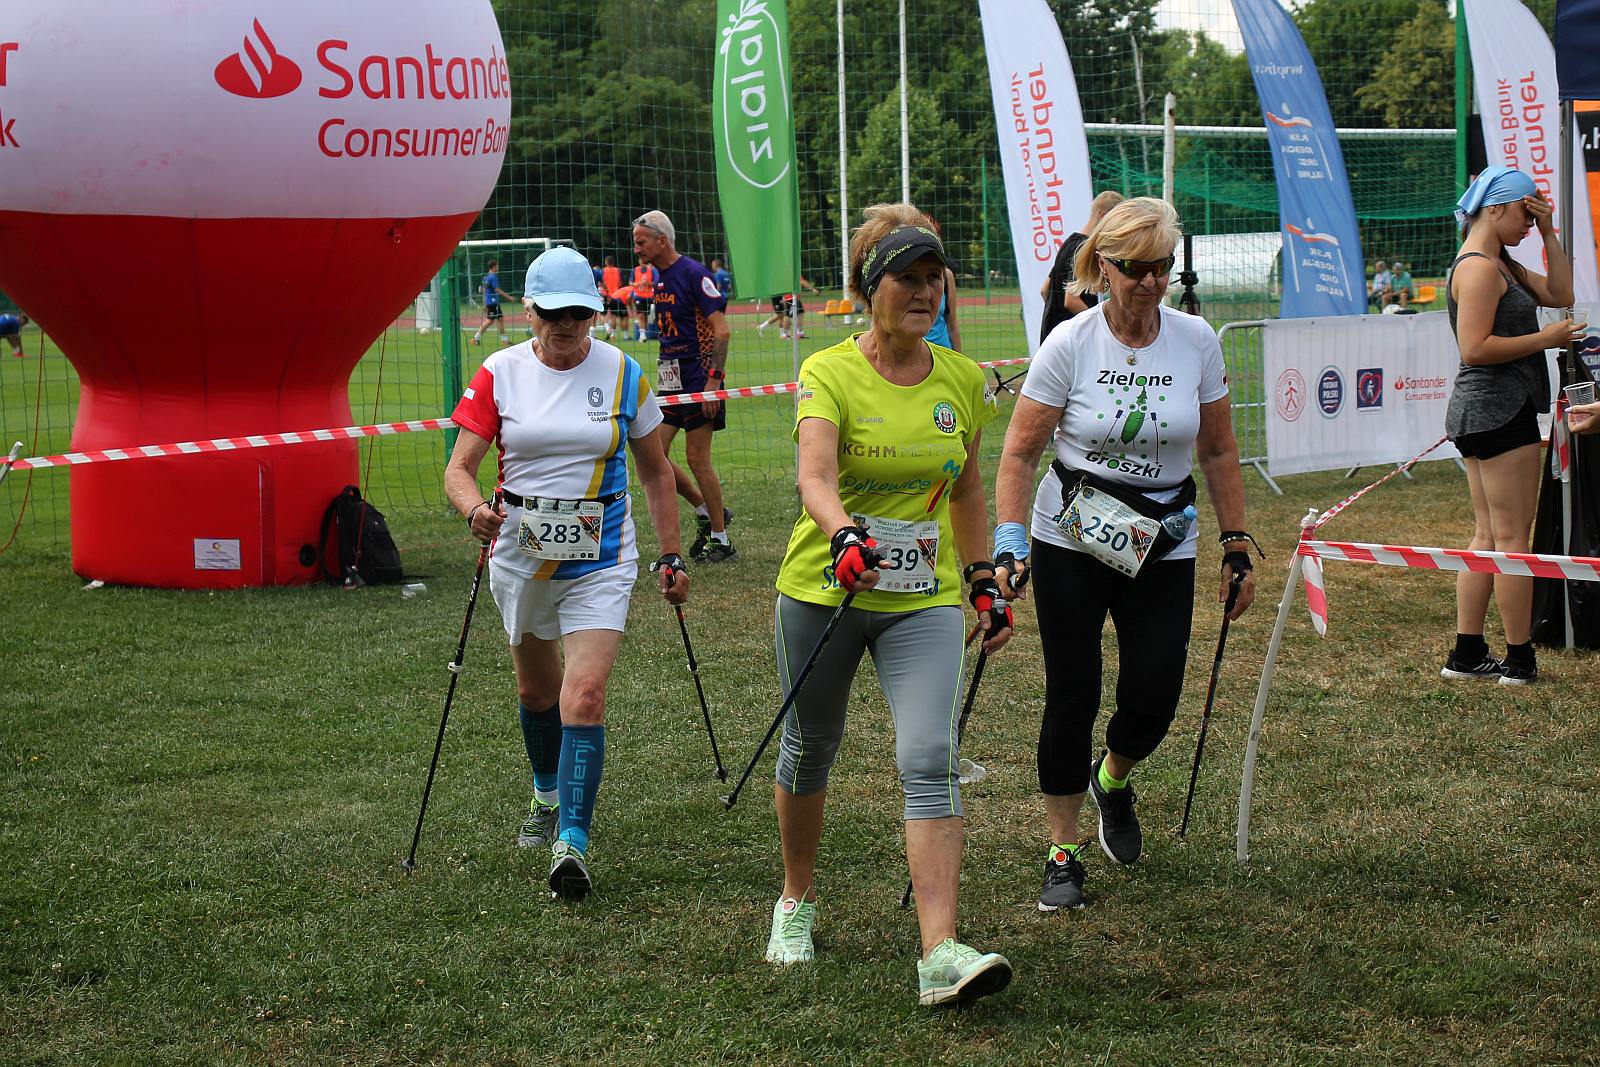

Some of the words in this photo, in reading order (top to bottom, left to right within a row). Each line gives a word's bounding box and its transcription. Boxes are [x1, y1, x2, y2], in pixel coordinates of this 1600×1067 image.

[316, 39, 510, 100] Santande
[318, 118, 483, 158] Consumer
[482, 117, 509, 154] Ban
[1096, 370, 1173, 387] Zielone
[1405, 377, 1447, 389] Santander
[1323, 390, 1339, 399] POLSKI
[1405, 392, 1432, 401] Consumer
[843, 441, 897, 458] KGHM
[1085, 451, 1163, 479] Groszki
[843, 474, 932, 492] Polkowice
[539, 522, 582, 544] 283
[1083, 515, 1129, 552] 250
